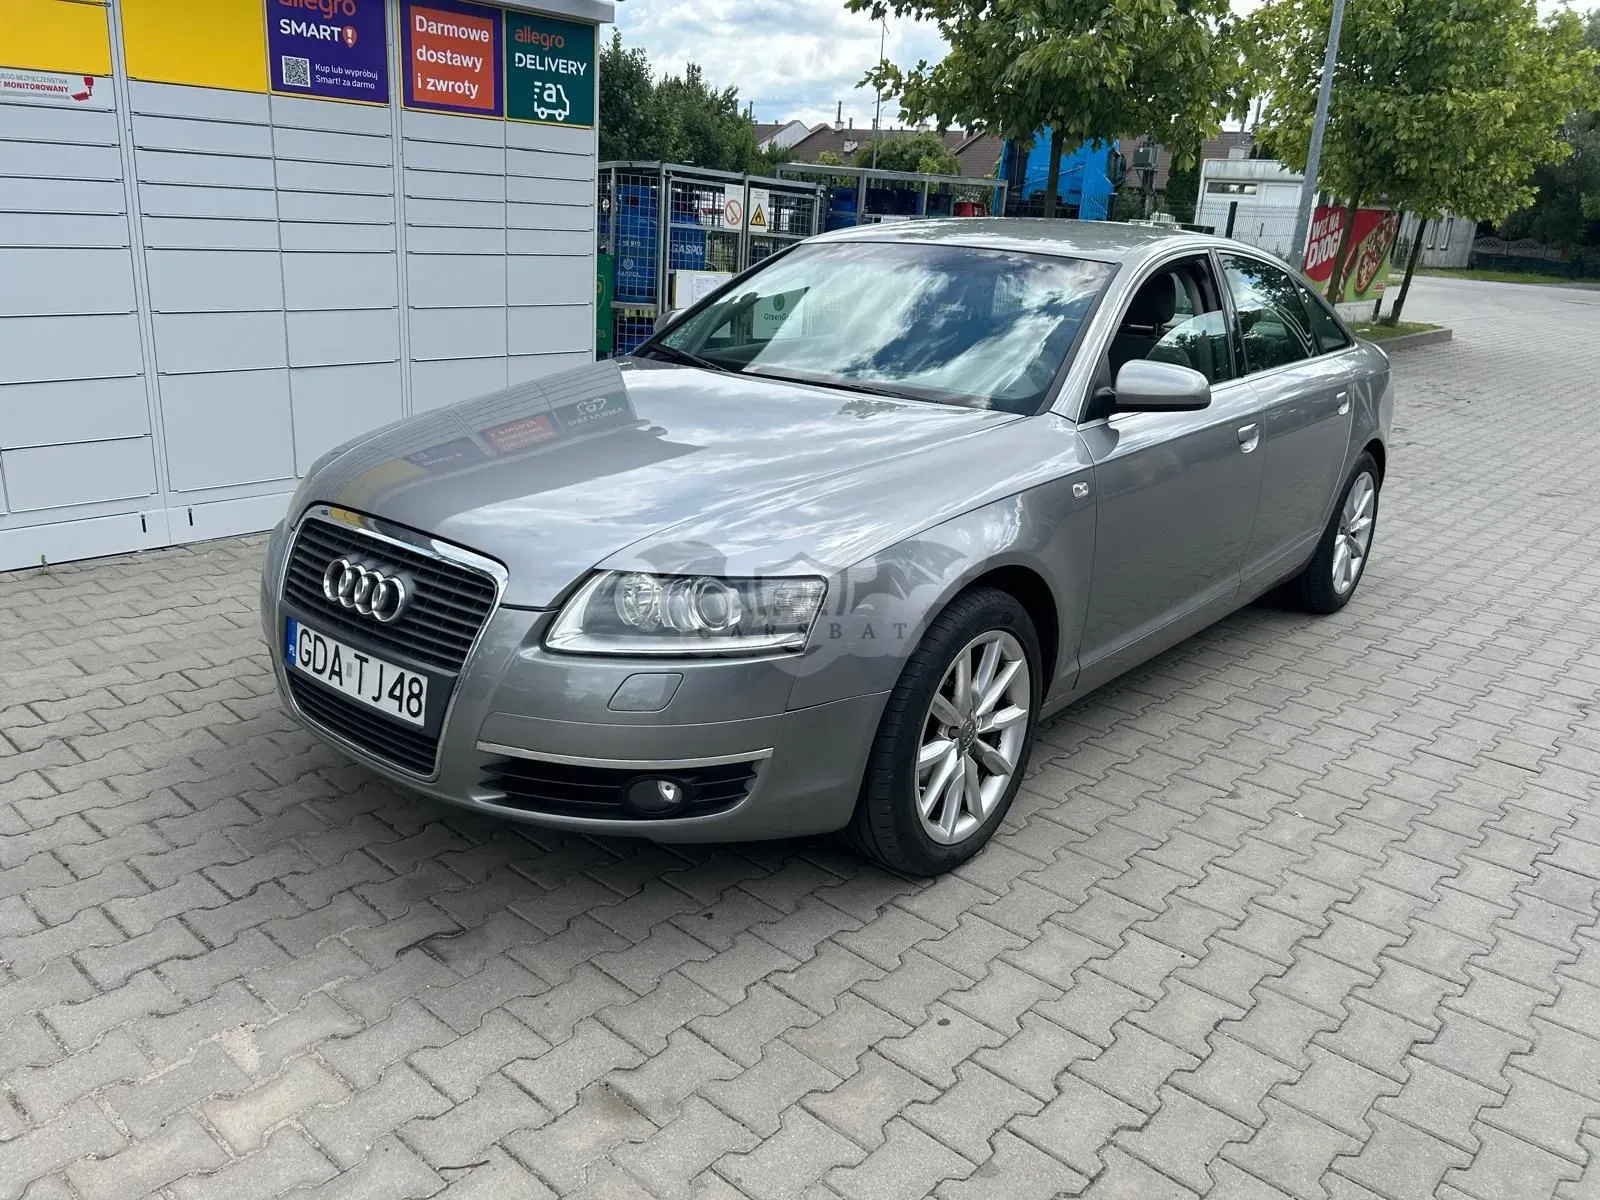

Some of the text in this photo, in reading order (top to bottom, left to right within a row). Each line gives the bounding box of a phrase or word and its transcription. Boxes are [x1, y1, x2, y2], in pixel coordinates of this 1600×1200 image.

[279, 0, 357, 19] egro
[415, 15, 490, 43] Darmowe
[515, 25, 565, 50] allegro
[416, 45, 483, 73] dostawy
[515, 52, 587, 76] DELIVERY
[0, 72, 68, 85] JEGO BEZPIECZEŃSTWA
[315, 64, 378, 80] Kup lub wypróbuj
[315, 75, 375, 90] Smart! za darmo
[3, 81, 69, 93] MONITOROWANY
[417, 73, 479, 100] i zwroty
[763, 312, 793, 321] GreenG
[299, 628, 344, 687] GDA
